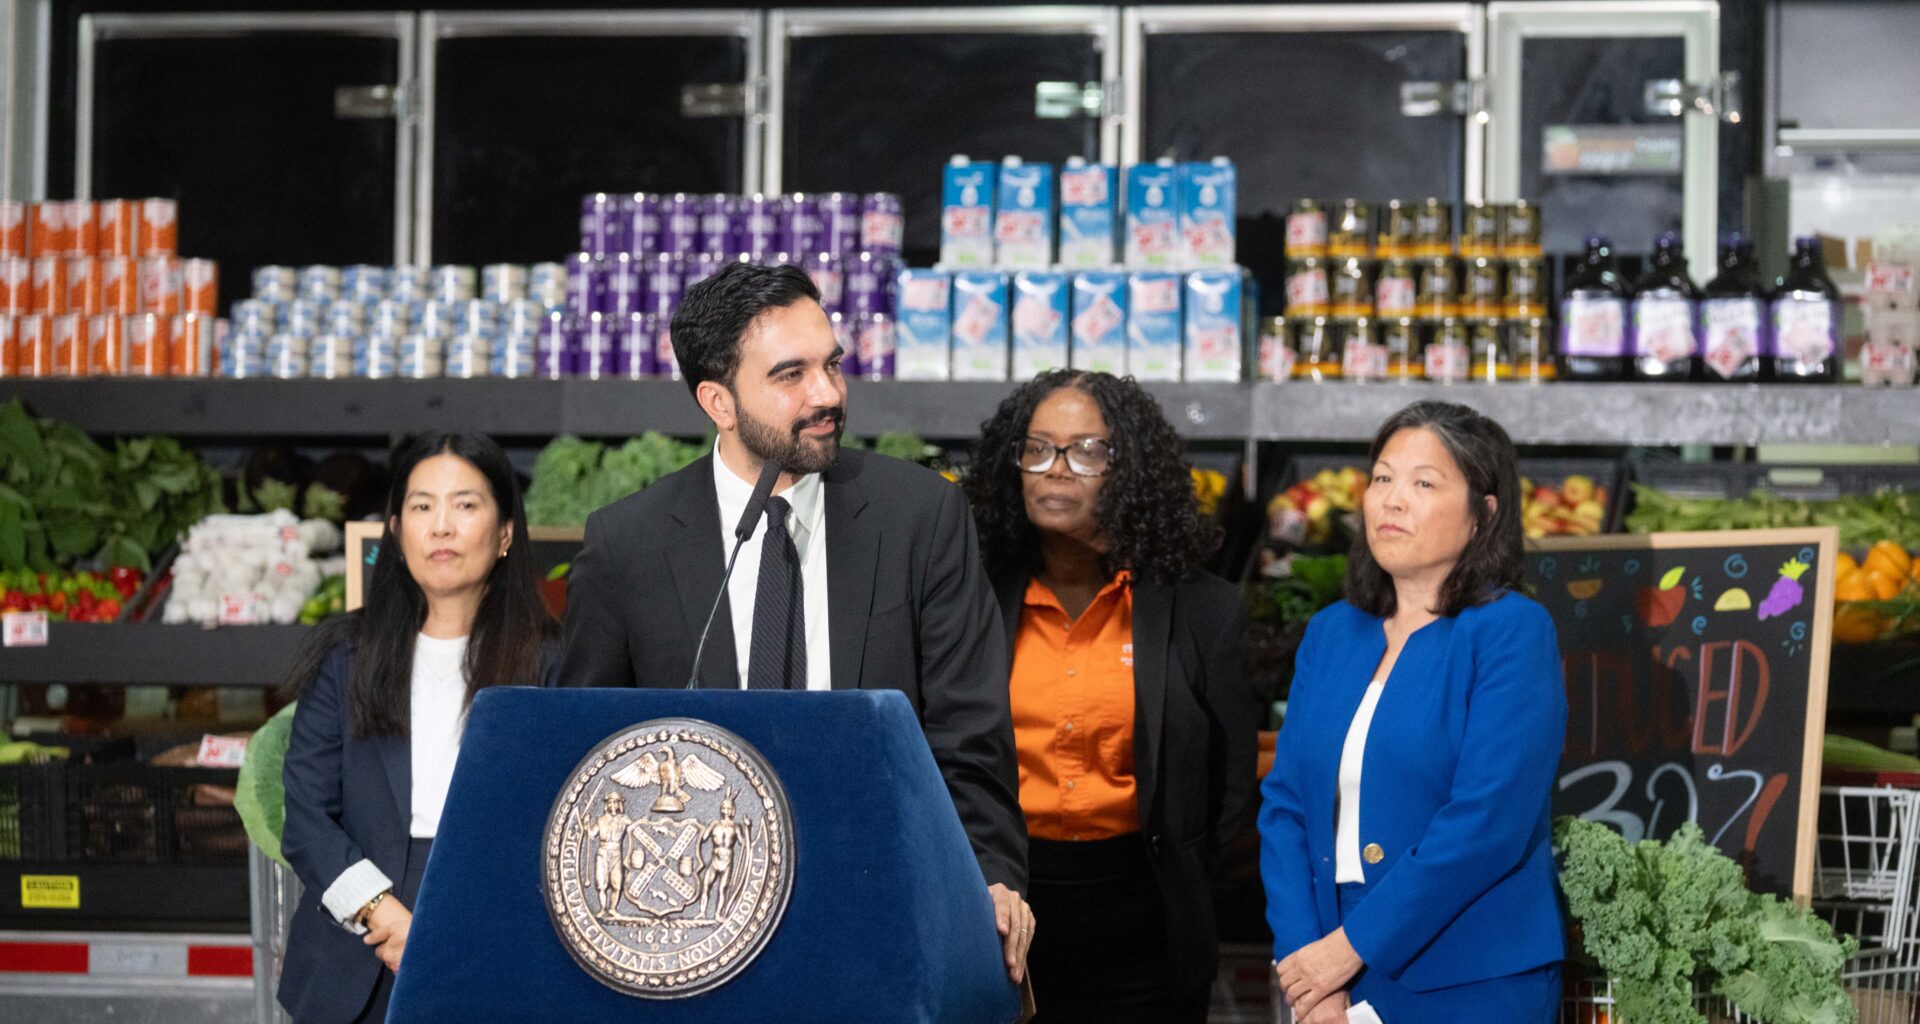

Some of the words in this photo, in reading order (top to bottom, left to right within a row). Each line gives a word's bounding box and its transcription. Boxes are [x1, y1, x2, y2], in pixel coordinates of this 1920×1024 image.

[584, 927, 666, 971] CIVITATIS
[678, 932, 725, 968] NOVI
[725, 858, 765, 936] EBORACI
[636, 929, 683, 945] 1625
